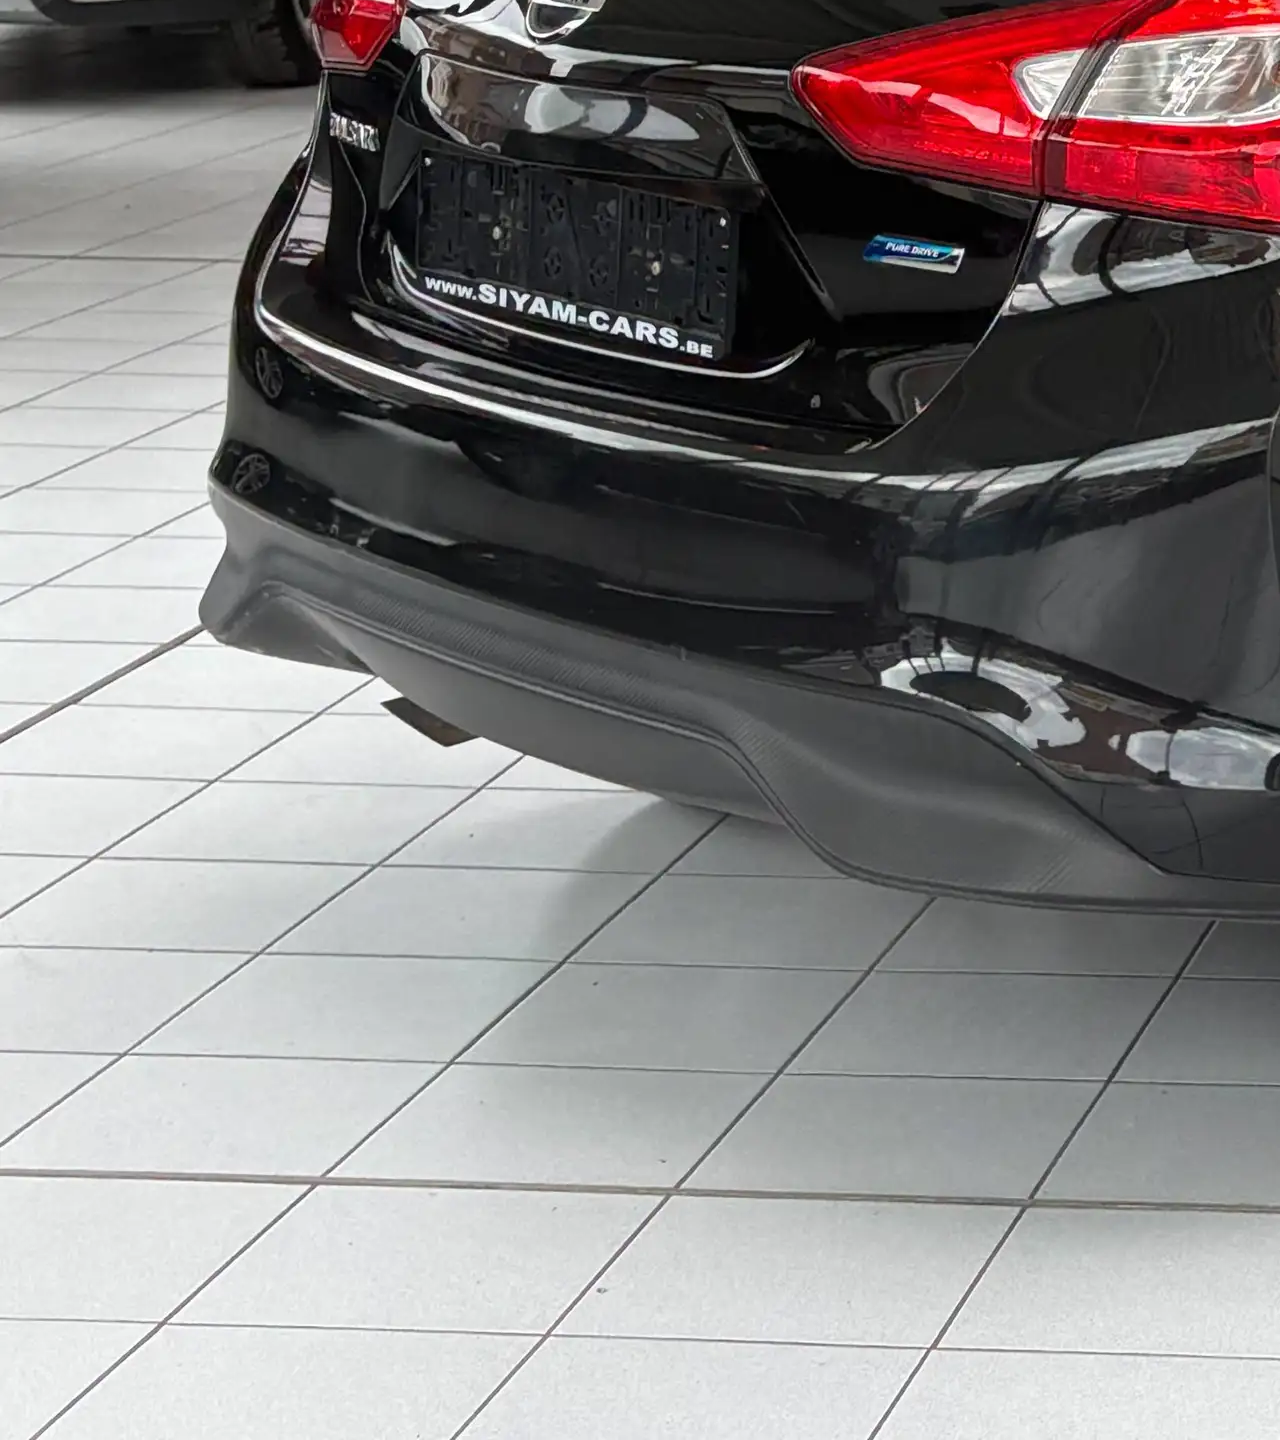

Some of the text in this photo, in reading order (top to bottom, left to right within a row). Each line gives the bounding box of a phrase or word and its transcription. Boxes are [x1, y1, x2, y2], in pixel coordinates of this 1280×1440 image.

[885, 241, 940, 258] PURE DRIVE
[424, 275, 714, 358] www.SIYAM-CARS.BE
